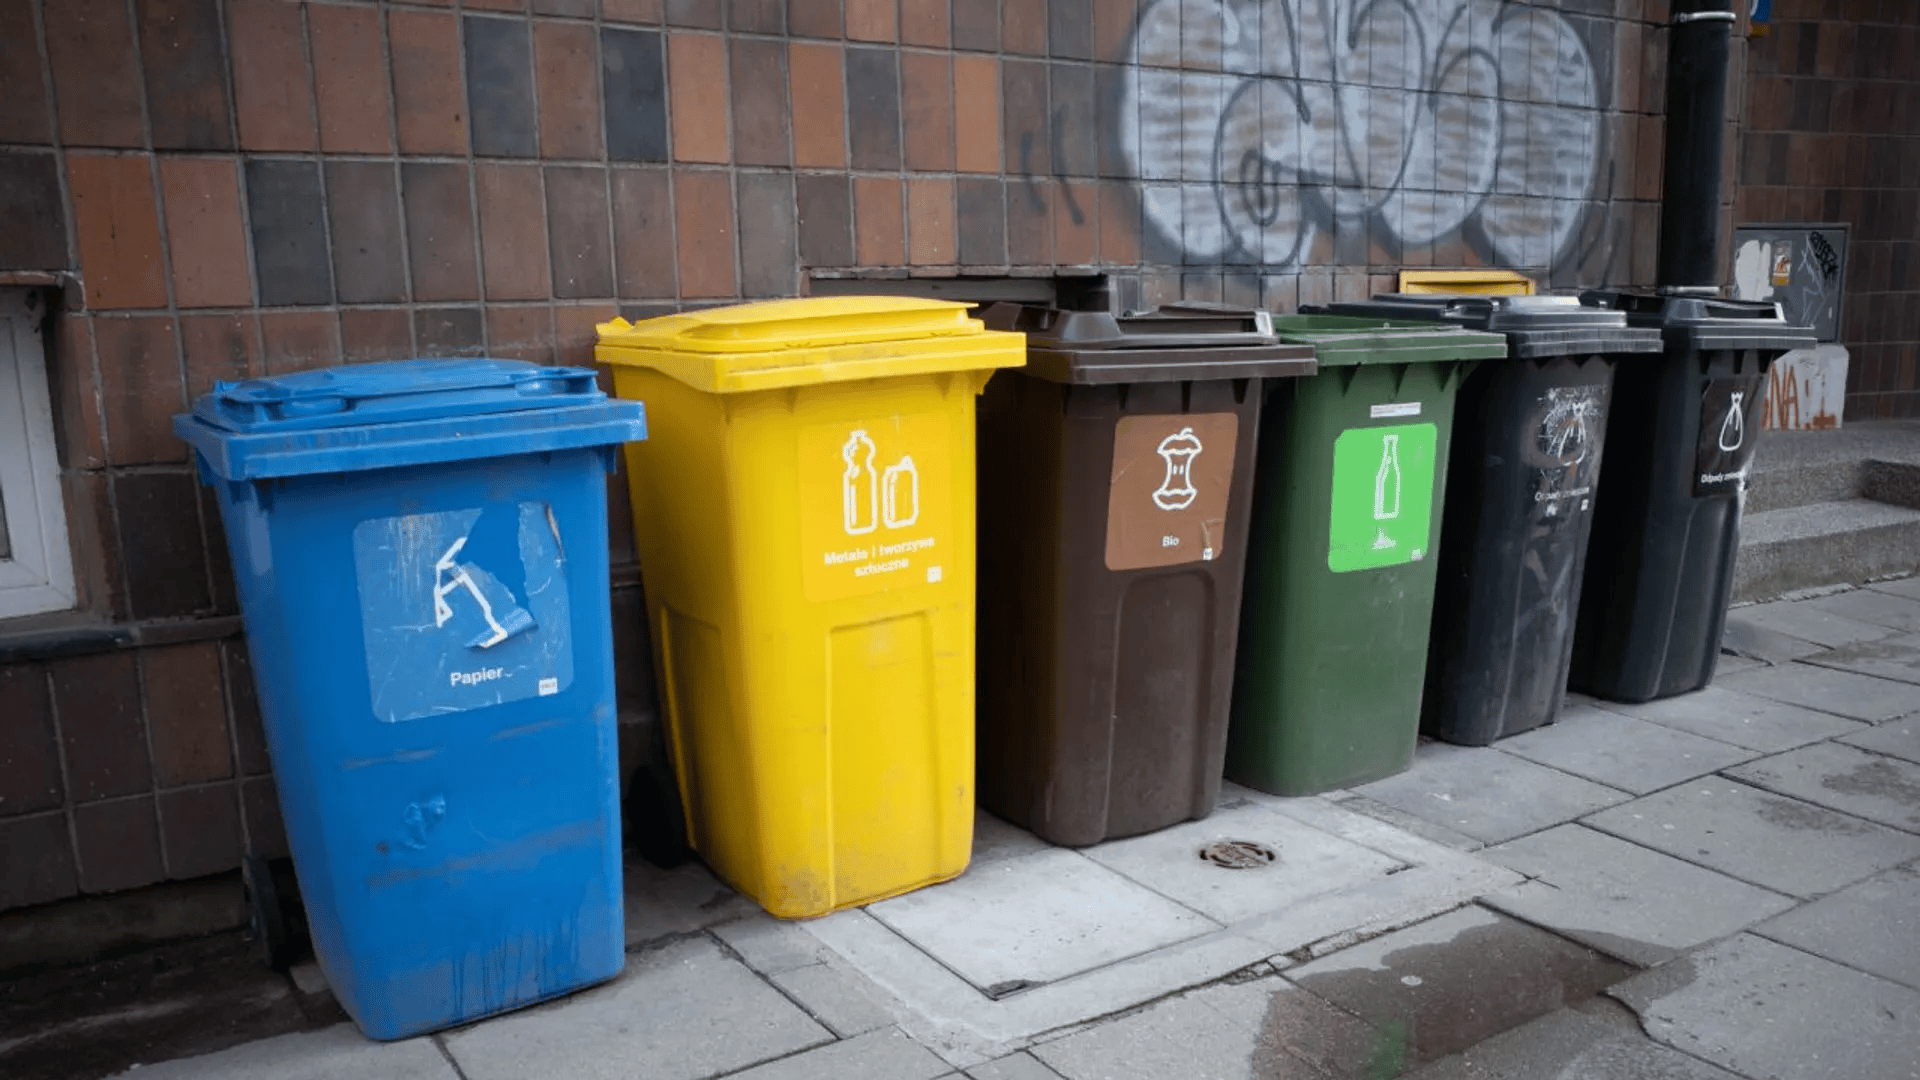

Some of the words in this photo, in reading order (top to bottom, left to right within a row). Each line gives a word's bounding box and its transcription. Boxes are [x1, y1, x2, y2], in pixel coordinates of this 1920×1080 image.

[1162, 535, 1180, 547] Bio
[824, 548, 868, 566] Metale
[450, 667, 503, 687] Papier
